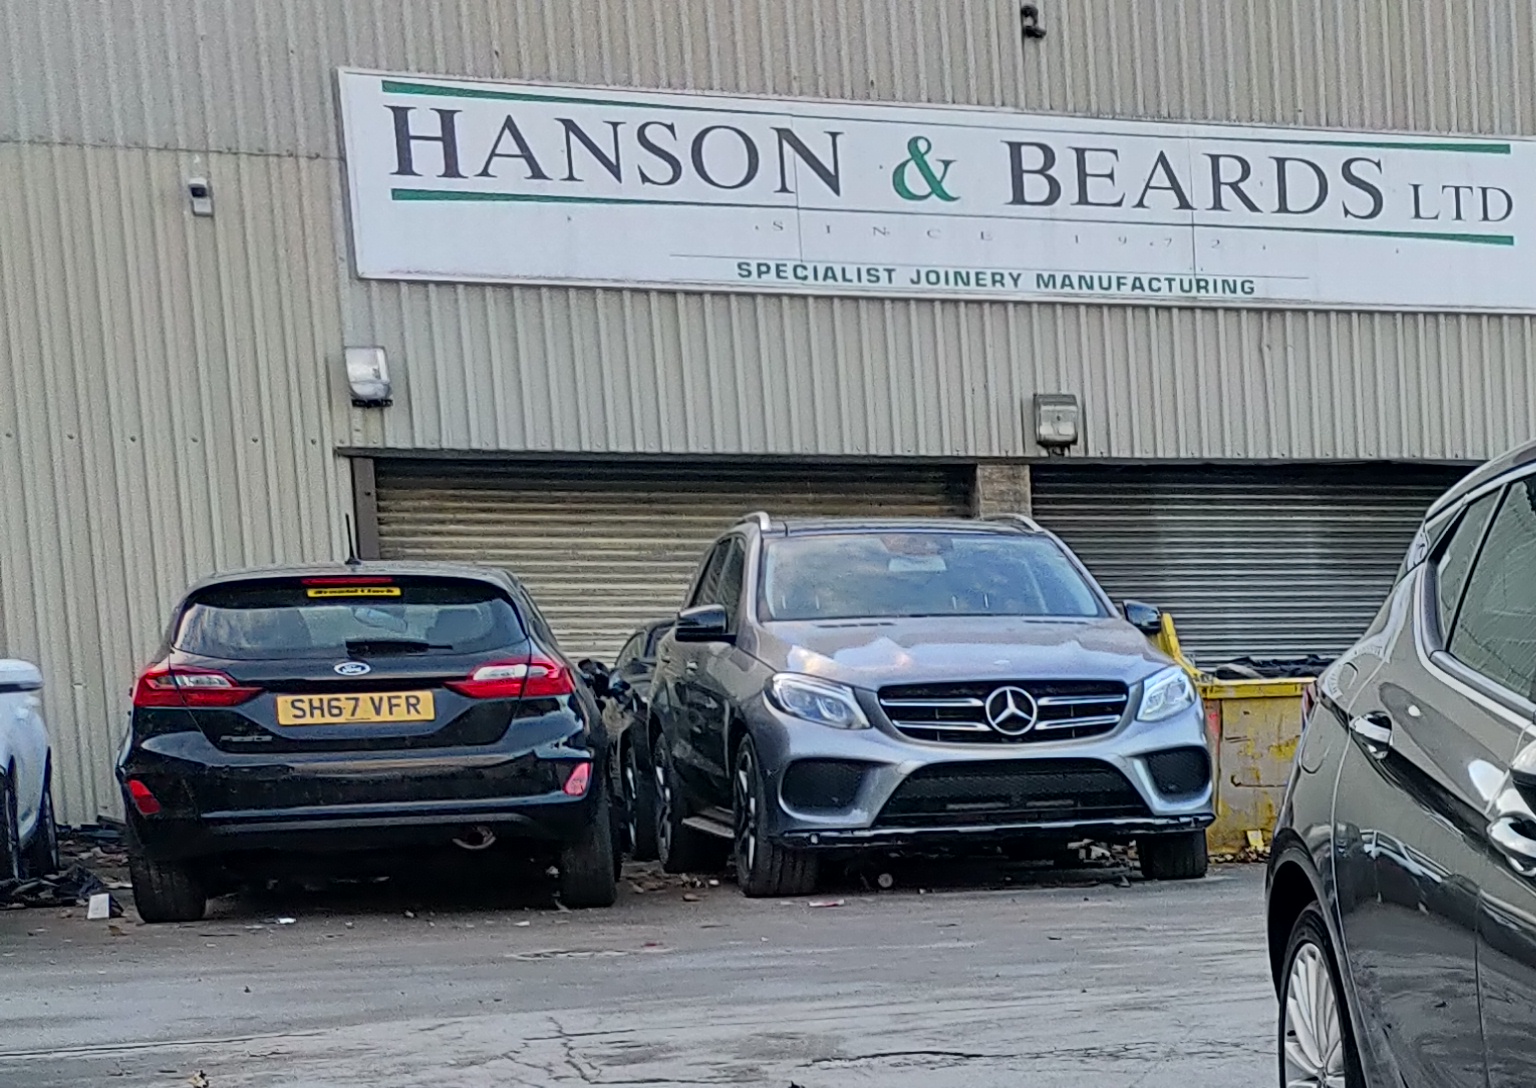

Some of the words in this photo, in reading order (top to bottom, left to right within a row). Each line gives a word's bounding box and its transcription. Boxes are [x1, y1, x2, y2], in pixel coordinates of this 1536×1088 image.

[384, 104, 844, 198] HANSON
[891, 135, 961, 203] &
[1001, 140, 1385, 220] BEARDS
[1408, 183, 1514, 223] LTD
[736, 261, 897, 285] SPECIALIST
[909, 268, 1023, 289] JOINERY
[1036, 272, 1256, 296] MANUFACTURING
[290, 696, 361, 719] SH67
[369, 695, 422, 717] VFR
